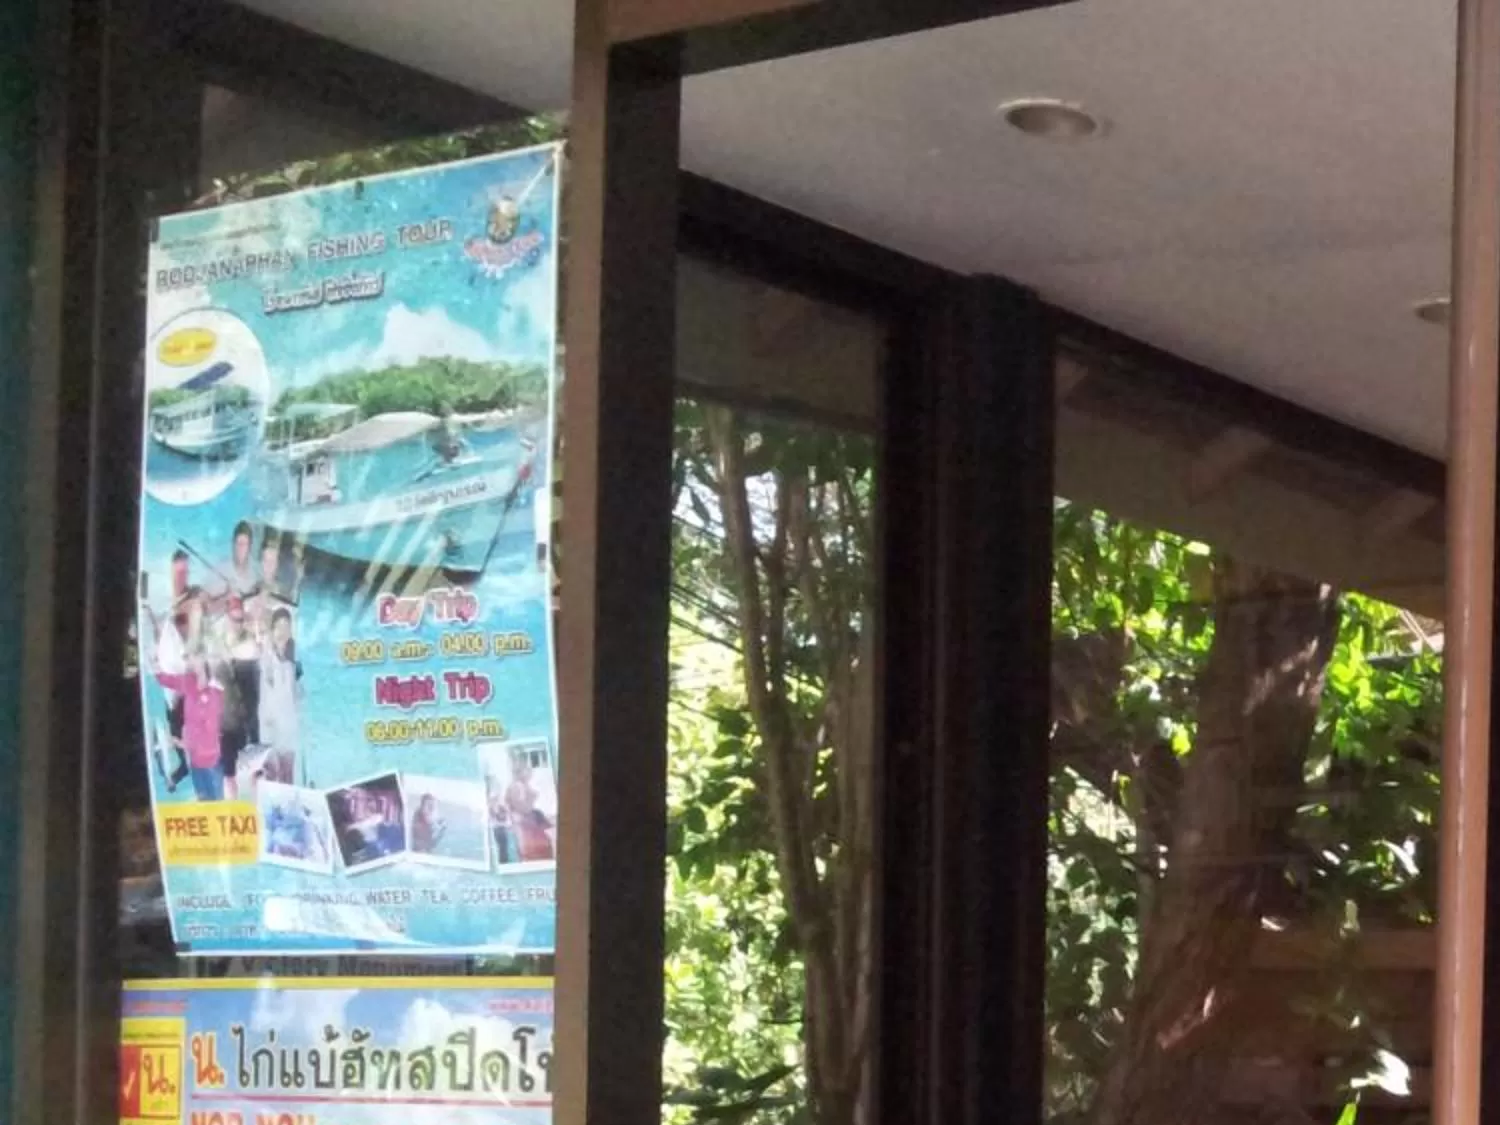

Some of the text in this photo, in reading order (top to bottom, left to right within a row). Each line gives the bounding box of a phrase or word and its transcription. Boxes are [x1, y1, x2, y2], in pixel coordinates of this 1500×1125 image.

[307, 231, 385, 261] FISHING
[396, 219, 453, 244] TOUR
[378, 592, 425, 628] Day
[375, 673, 493, 709] Night Trip
[164, 814, 257, 840] FREE TAXI
